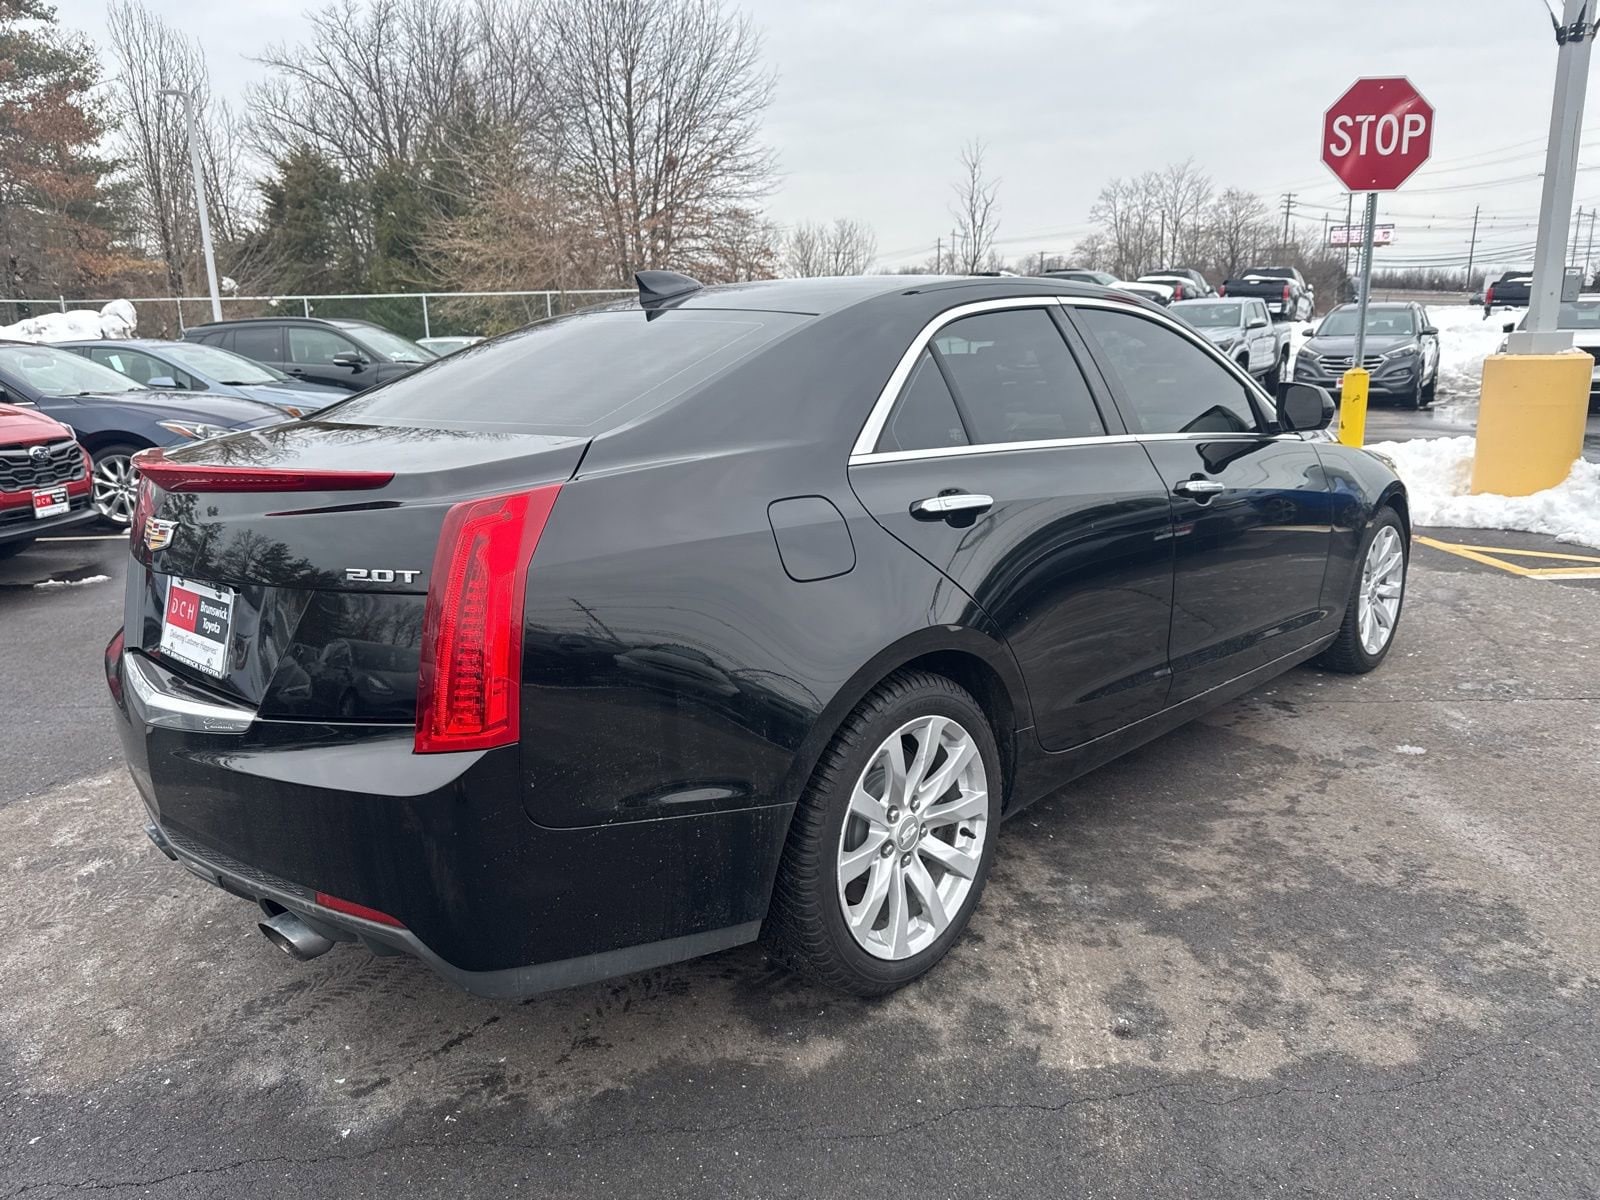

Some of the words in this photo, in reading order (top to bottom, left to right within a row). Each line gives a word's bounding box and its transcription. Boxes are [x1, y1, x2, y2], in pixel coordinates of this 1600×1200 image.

[1330, 114, 1426, 157] STOP
[172, 598, 195, 620] DCH
[200, 600, 228, 620] Brunswick
[203, 618, 220, 634] Toyota
[199, 664, 219, 677] TOYOTA
